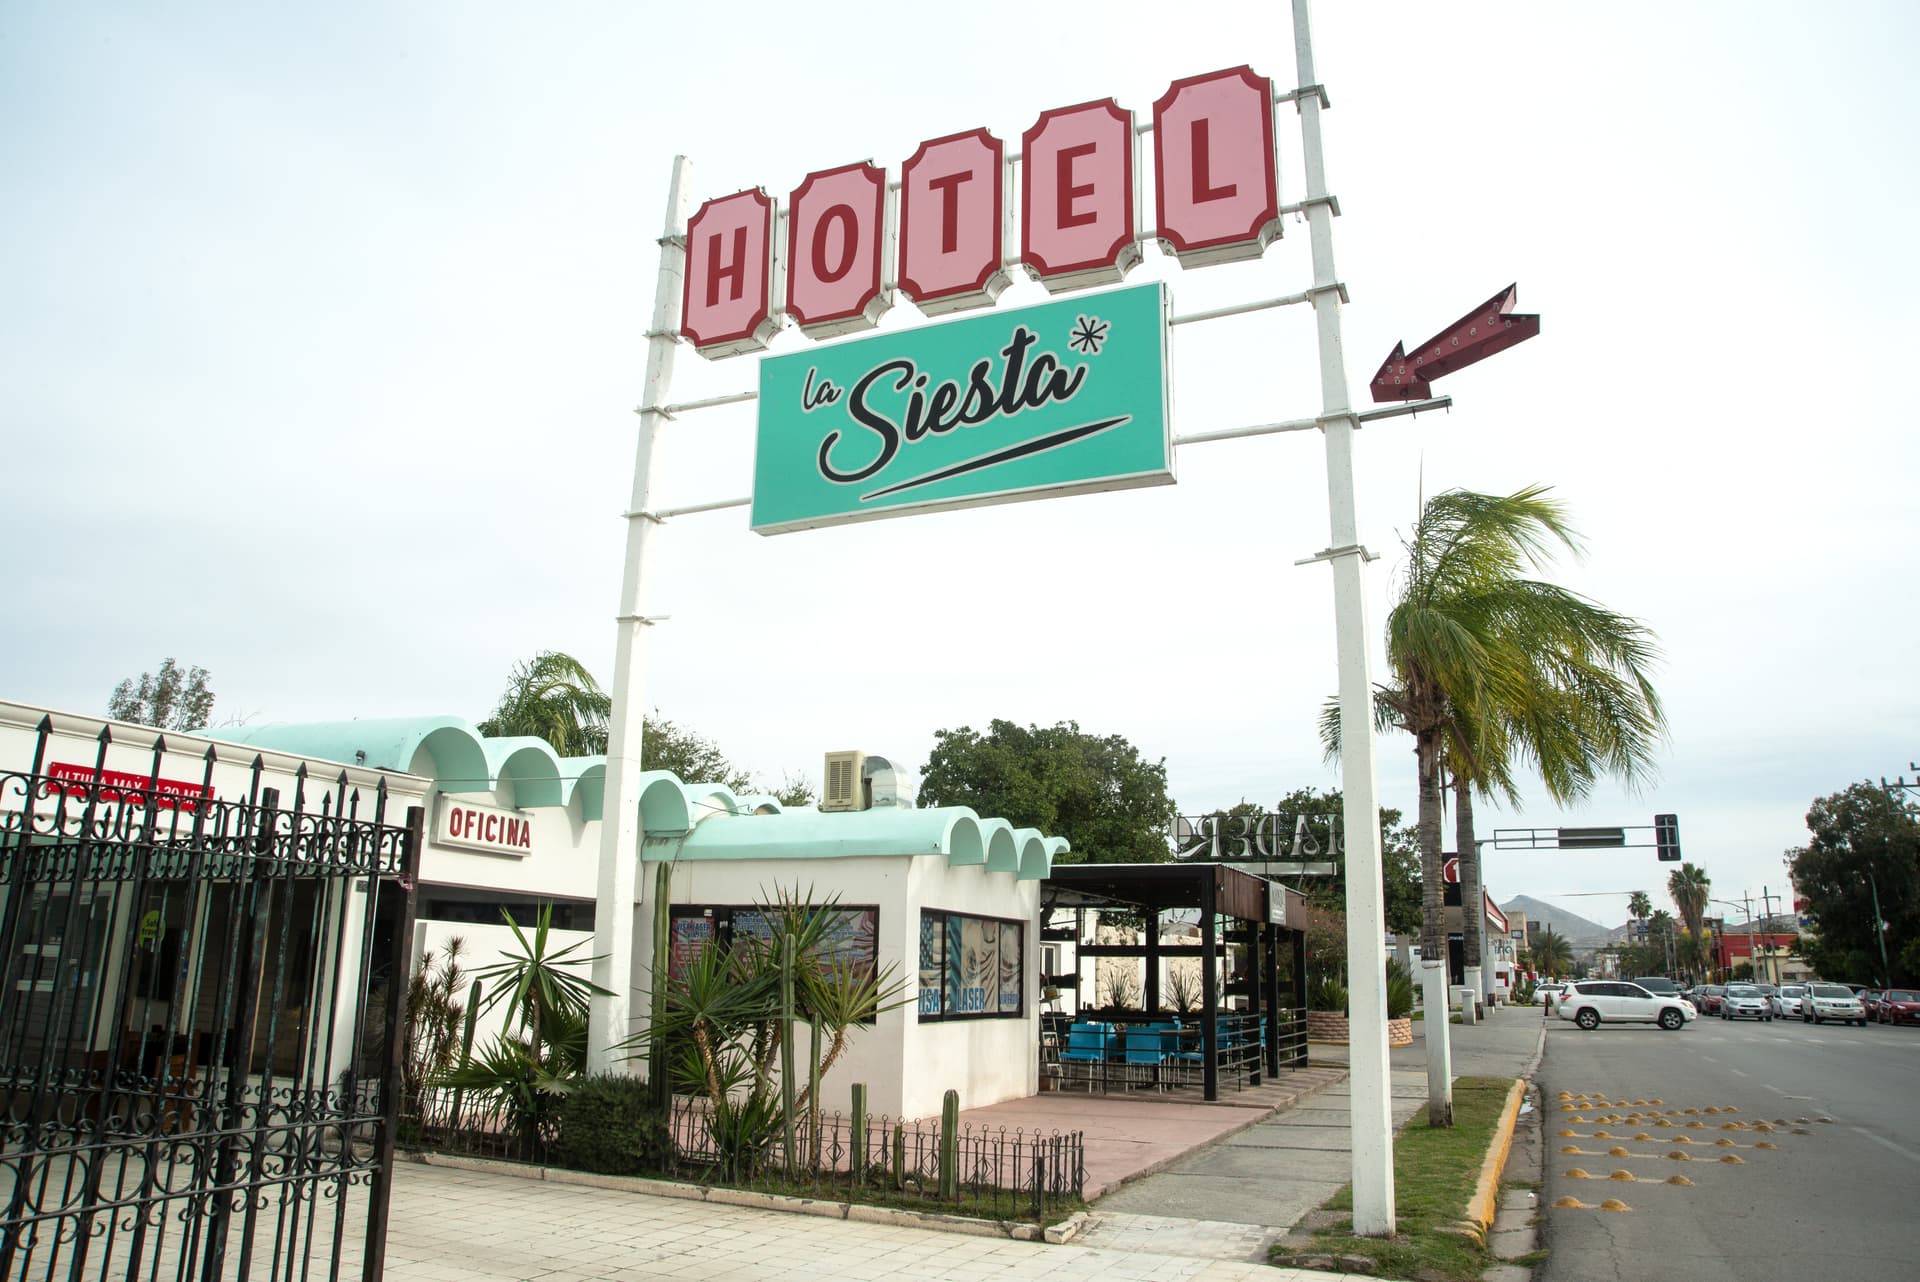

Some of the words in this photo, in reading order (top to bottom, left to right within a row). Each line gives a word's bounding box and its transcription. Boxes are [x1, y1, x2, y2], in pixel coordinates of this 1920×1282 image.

[704, 117, 1238, 309] HOTEL
[803, 366, 842, 413] la
[818, 326, 1087, 484] Siesta
[56, 769, 106, 791] ALTUA
[449, 806, 530, 848] OFICINA
[957, 987, 985, 1011] LASER
